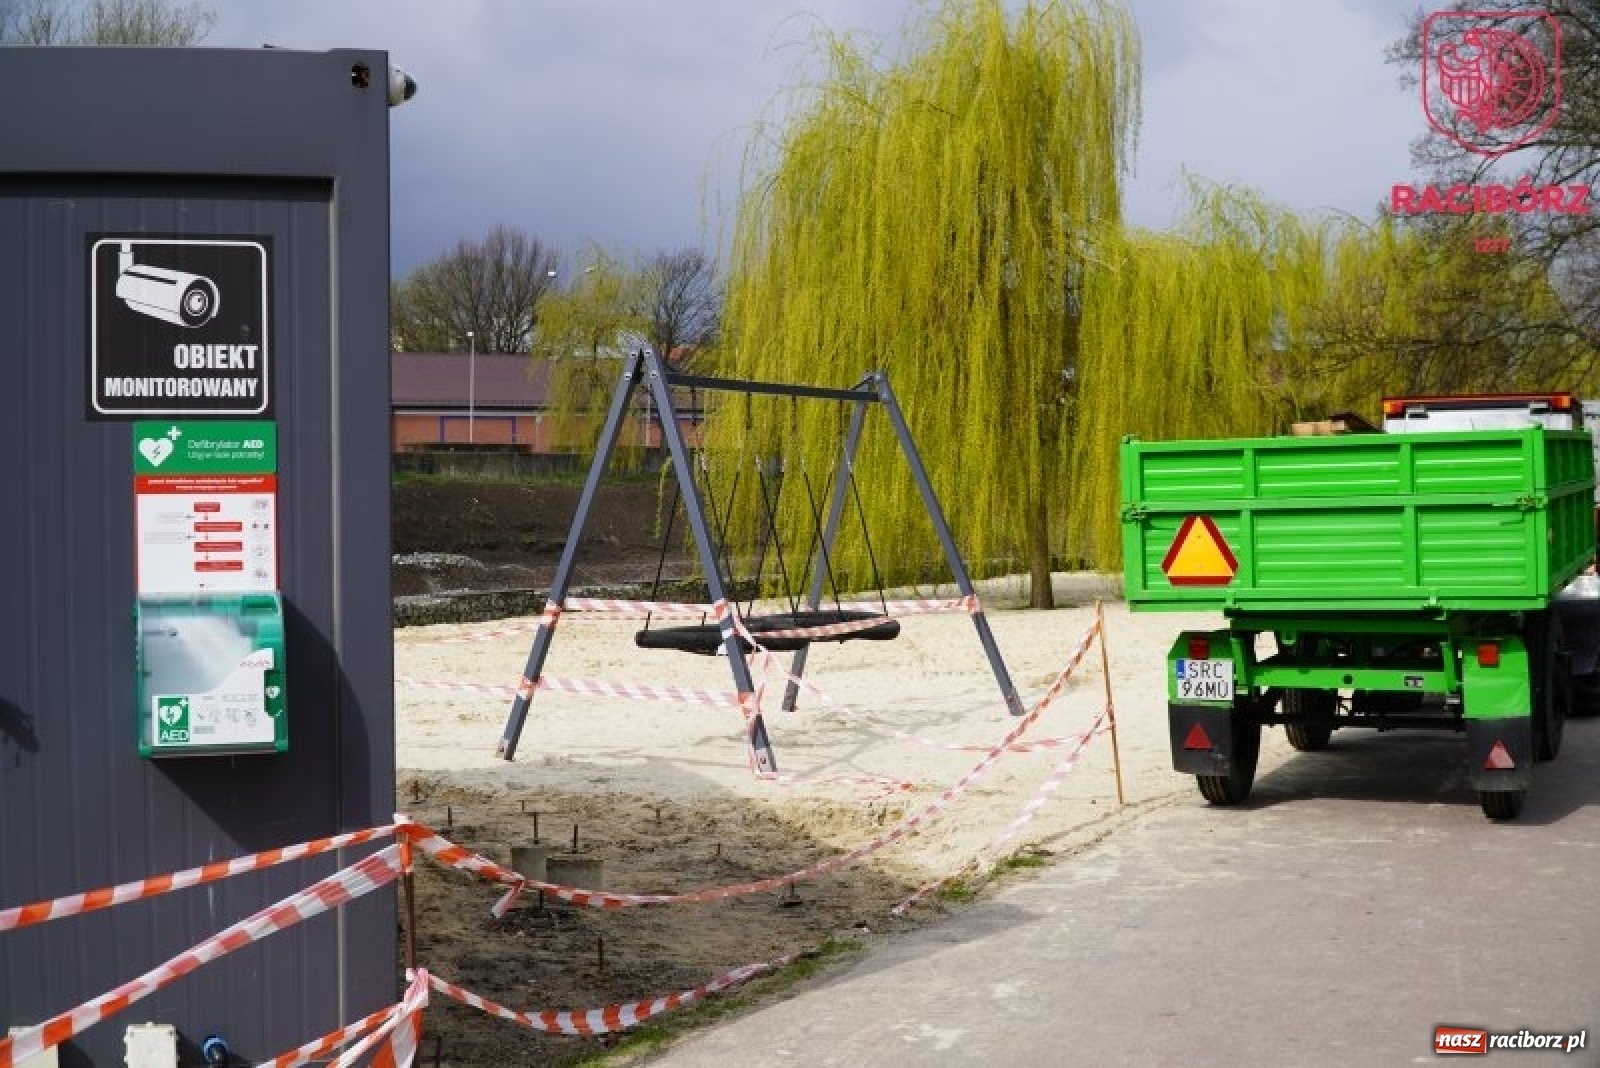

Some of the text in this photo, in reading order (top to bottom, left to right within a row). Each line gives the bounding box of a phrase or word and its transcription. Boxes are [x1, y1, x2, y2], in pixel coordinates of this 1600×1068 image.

[173, 344, 258, 369] OBIEKT
[104, 377, 258, 397] MONITOROWANY
[242, 439, 264, 449] AED
[1188, 662, 1222, 678] SRC
[1182, 681, 1228, 698] 96MU
[161, 729, 189, 741] AED
